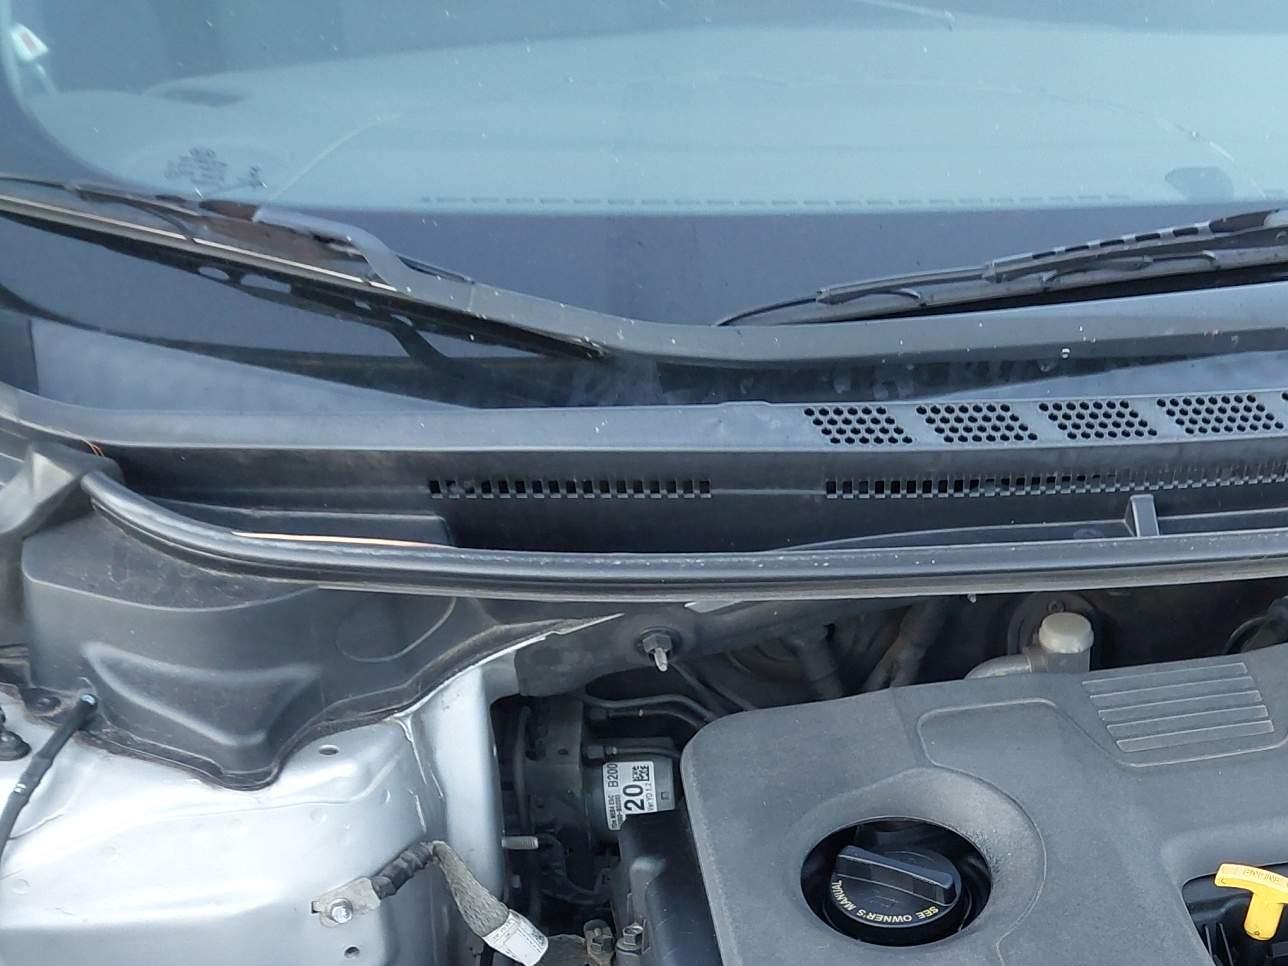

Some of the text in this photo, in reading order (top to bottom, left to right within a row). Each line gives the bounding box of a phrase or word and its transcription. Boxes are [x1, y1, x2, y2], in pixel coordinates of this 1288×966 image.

[606, 763, 619, 788] B200
[622, 784, 645, 811] 20
[831, 880, 939, 923] SEE OWNER'S MANUAL
